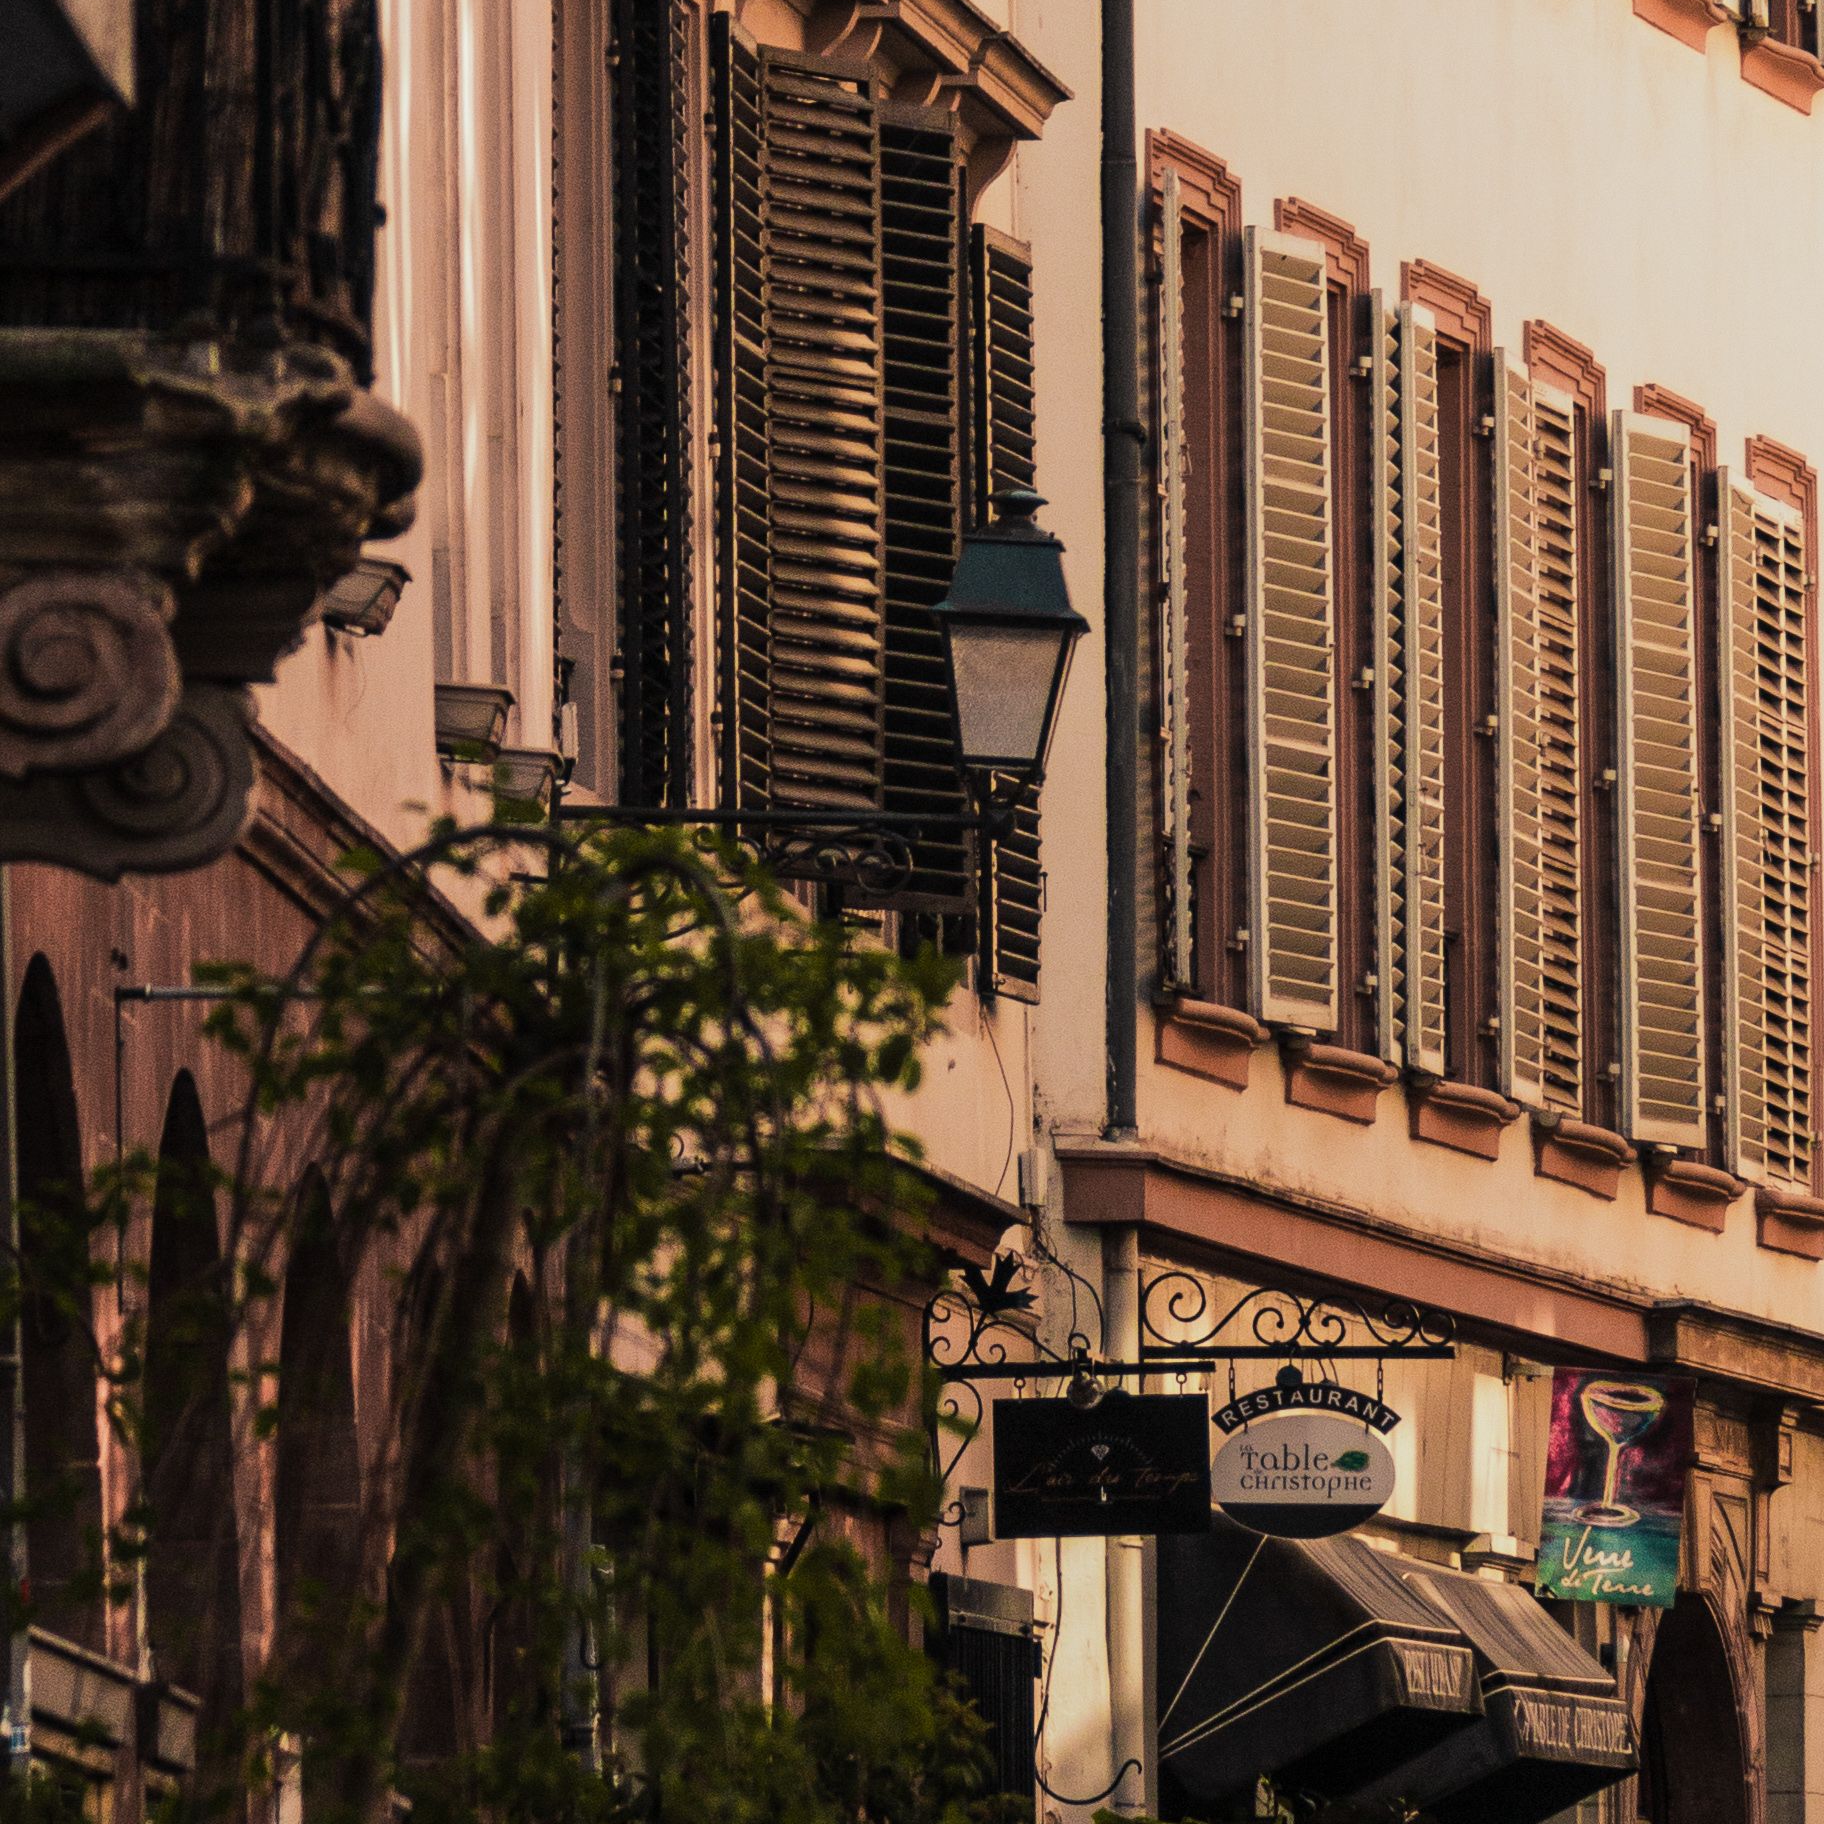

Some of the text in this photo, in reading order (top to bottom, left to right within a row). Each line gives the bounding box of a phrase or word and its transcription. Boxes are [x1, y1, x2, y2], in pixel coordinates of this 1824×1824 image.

[1221, 1388, 1395, 1428] RESTAURANT
[1240, 1443, 1328, 1471] Table
[1563, 1525, 1634, 1570] Verre
[1582, 1567, 1654, 1595] Terre
